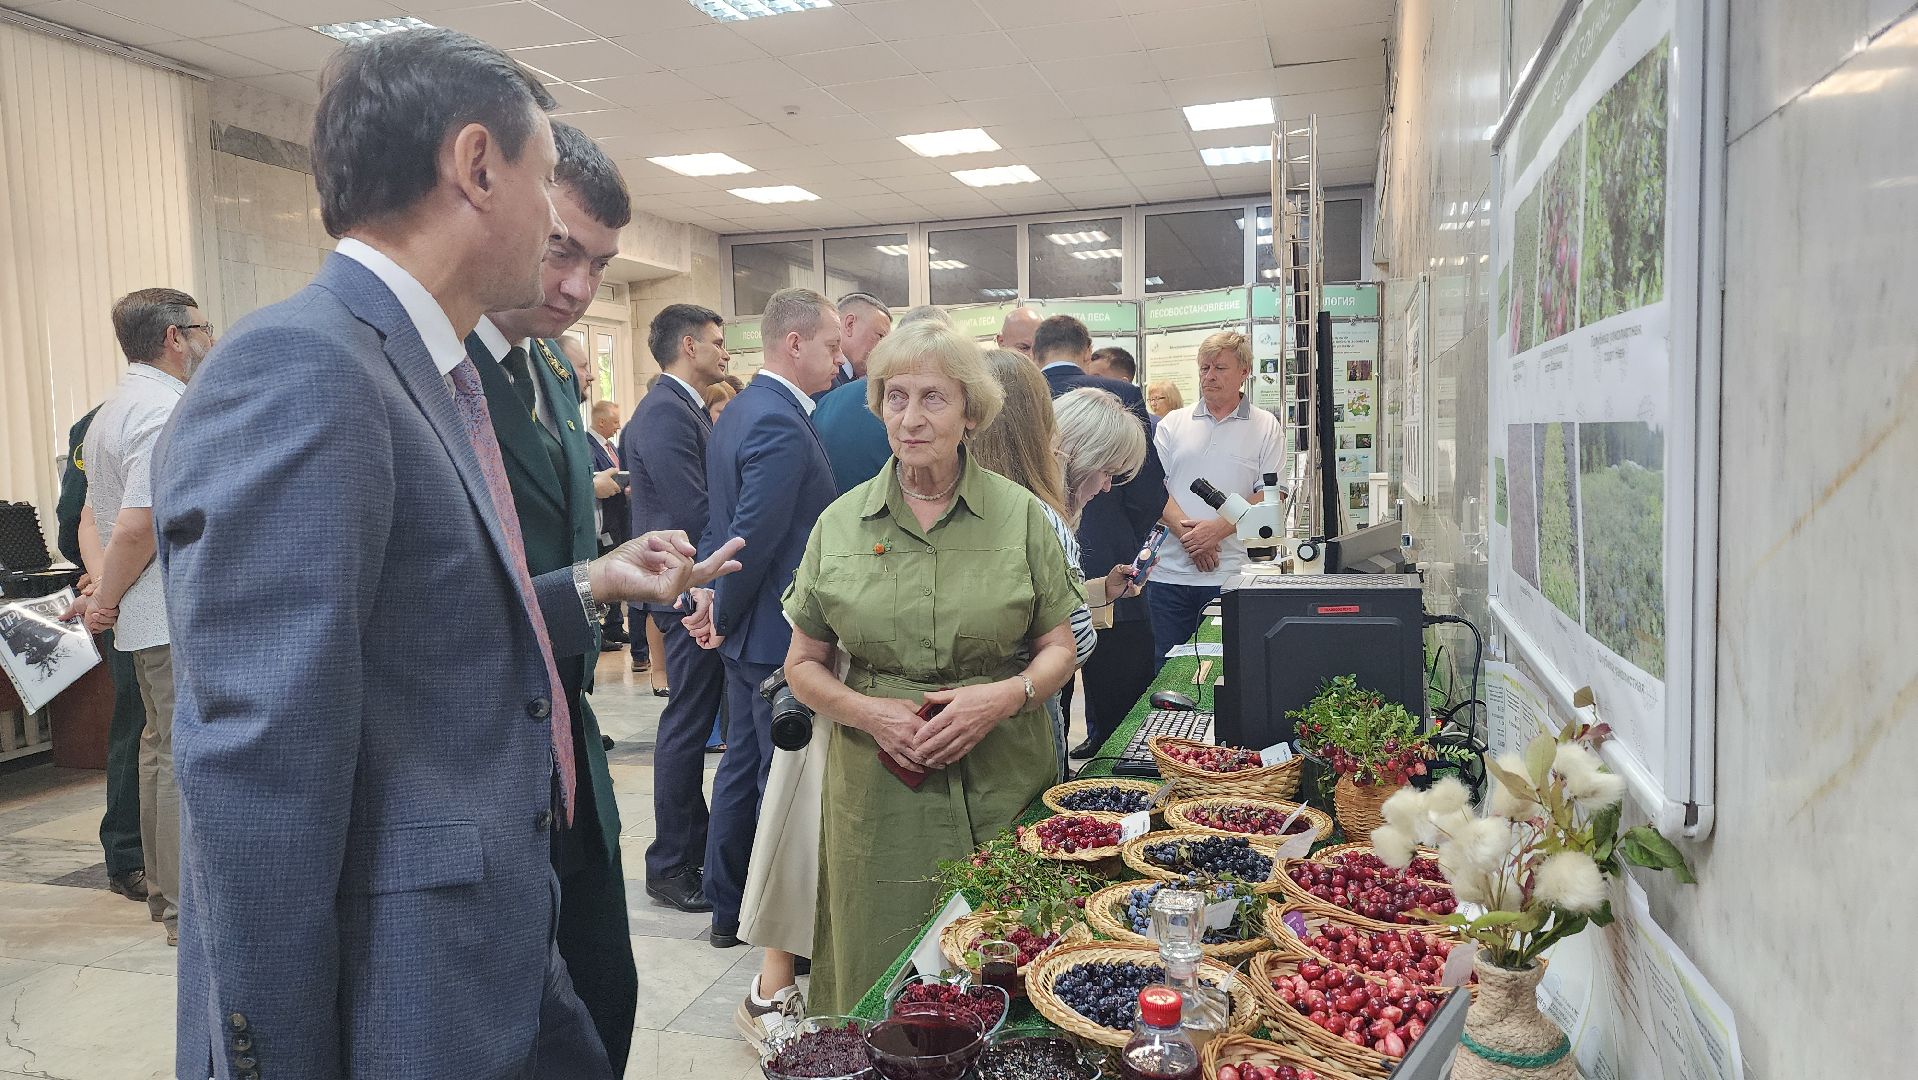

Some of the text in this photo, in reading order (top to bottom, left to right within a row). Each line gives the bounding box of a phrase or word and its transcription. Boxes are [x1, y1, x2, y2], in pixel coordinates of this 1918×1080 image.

[1275, 296, 1355, 308] РДЛОГИЯ
[1150, 299, 1241, 319] ЛЕСОВОССТАНОВЛЕНИЕ
[1088, 312, 1110, 321] ЛЕСА
